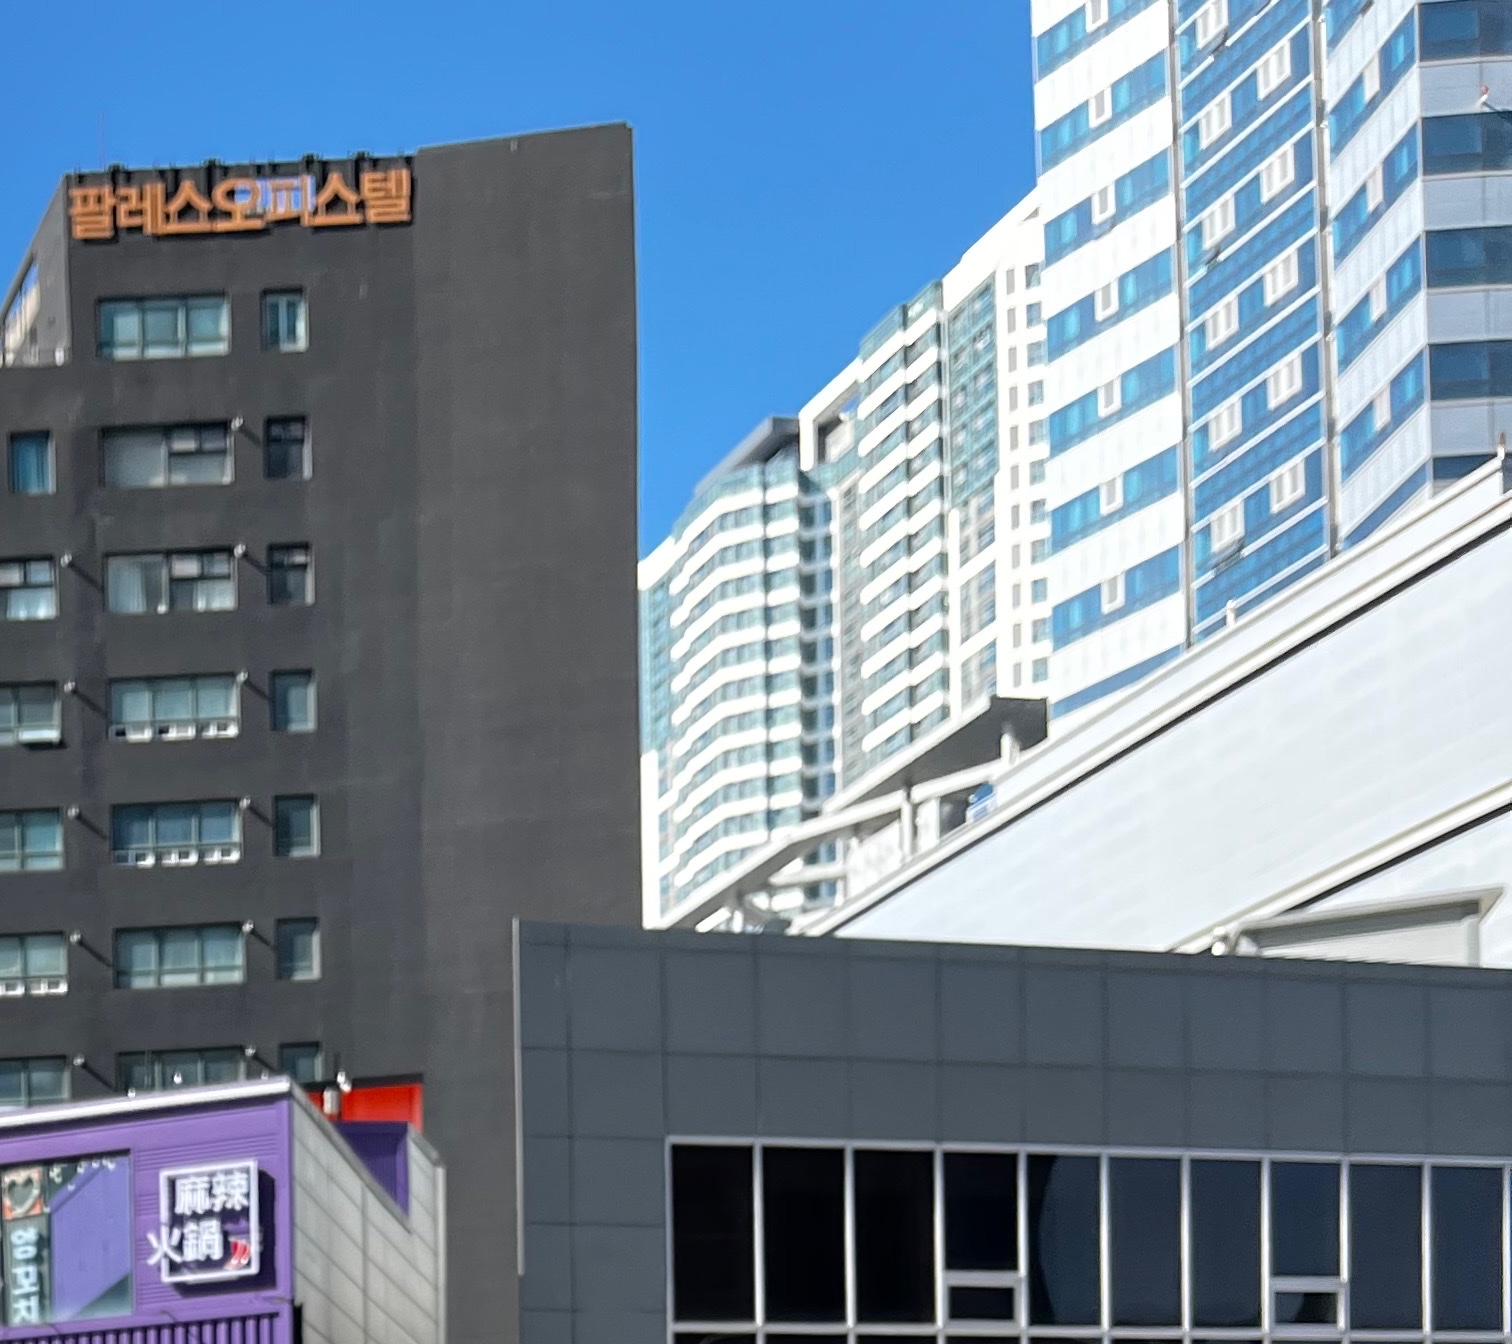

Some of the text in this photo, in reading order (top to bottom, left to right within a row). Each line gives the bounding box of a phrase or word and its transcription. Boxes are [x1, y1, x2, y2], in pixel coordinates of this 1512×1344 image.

[70, 168, 412, 240] 팔레스오피스텔
[174, 1170, 249, 1215] 麻辣
[147, 1218, 224, 1265] 火鍋
